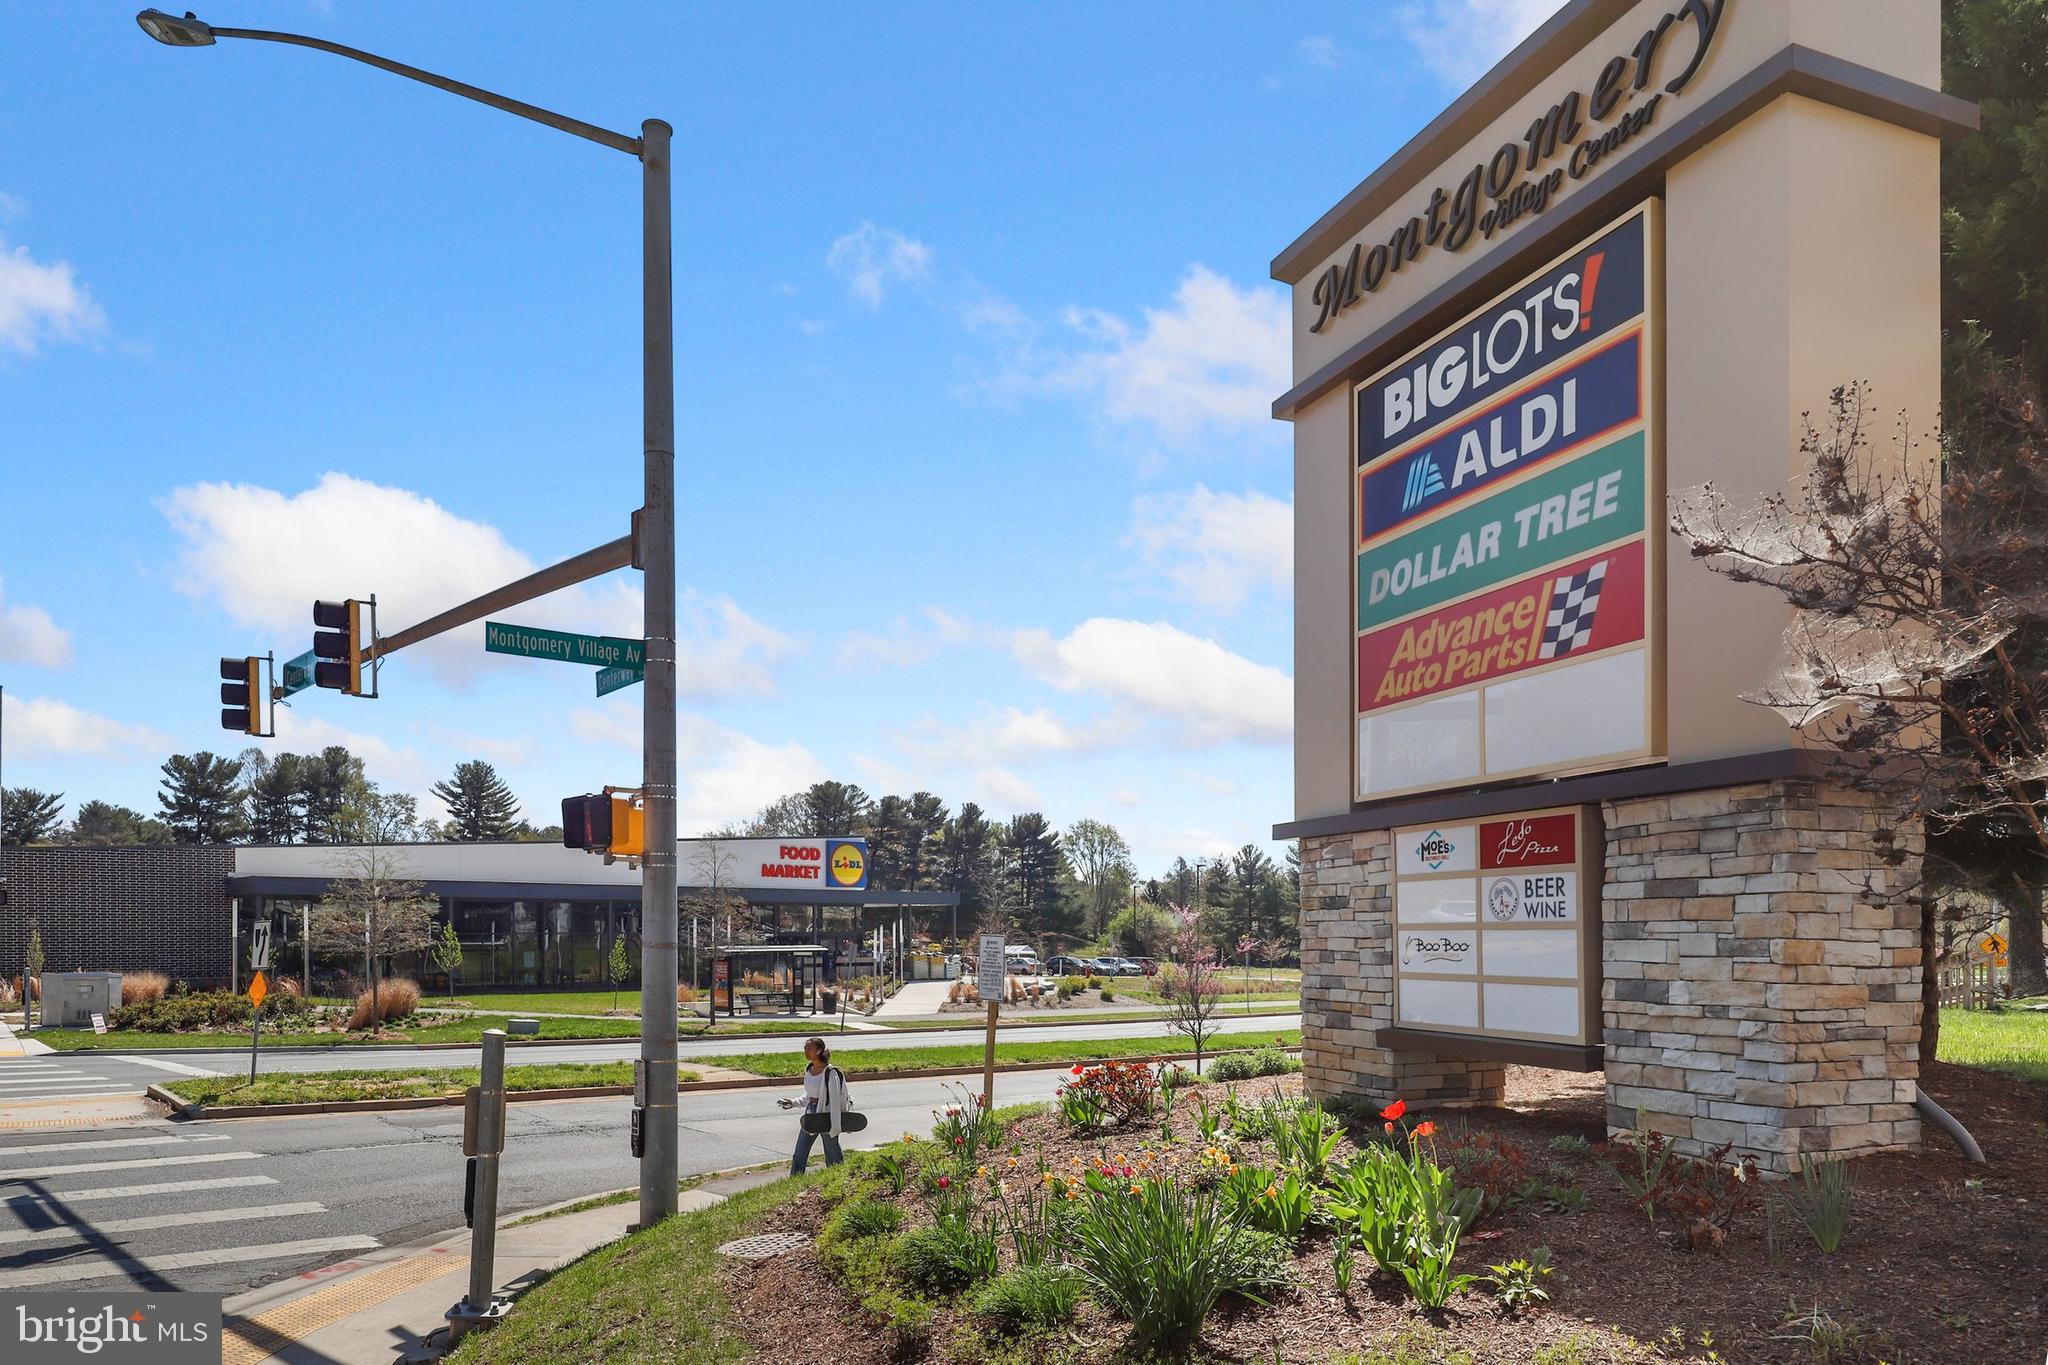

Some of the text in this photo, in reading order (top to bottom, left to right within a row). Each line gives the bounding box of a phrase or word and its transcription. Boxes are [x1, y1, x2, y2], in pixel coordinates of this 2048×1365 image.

[1309, 0, 1726, 333] Montgomery
[1479, 94, 1662, 240] Village Center
[1451, 377, 1577, 490] ALDI
[1368, 469, 1622, 606] DOLLAR TREE
[489, 627, 641, 665] Montgomery Village Av
[1389, 595, 1536, 668] Advance
[1374, 634, 1528, 703] Auto Parts
[761, 863, 821, 879] MARKET
[780, 846, 821, 861] FOOD
[1524, 877, 1566, 898] BEER
[1524, 901, 1566, 918] WINE
